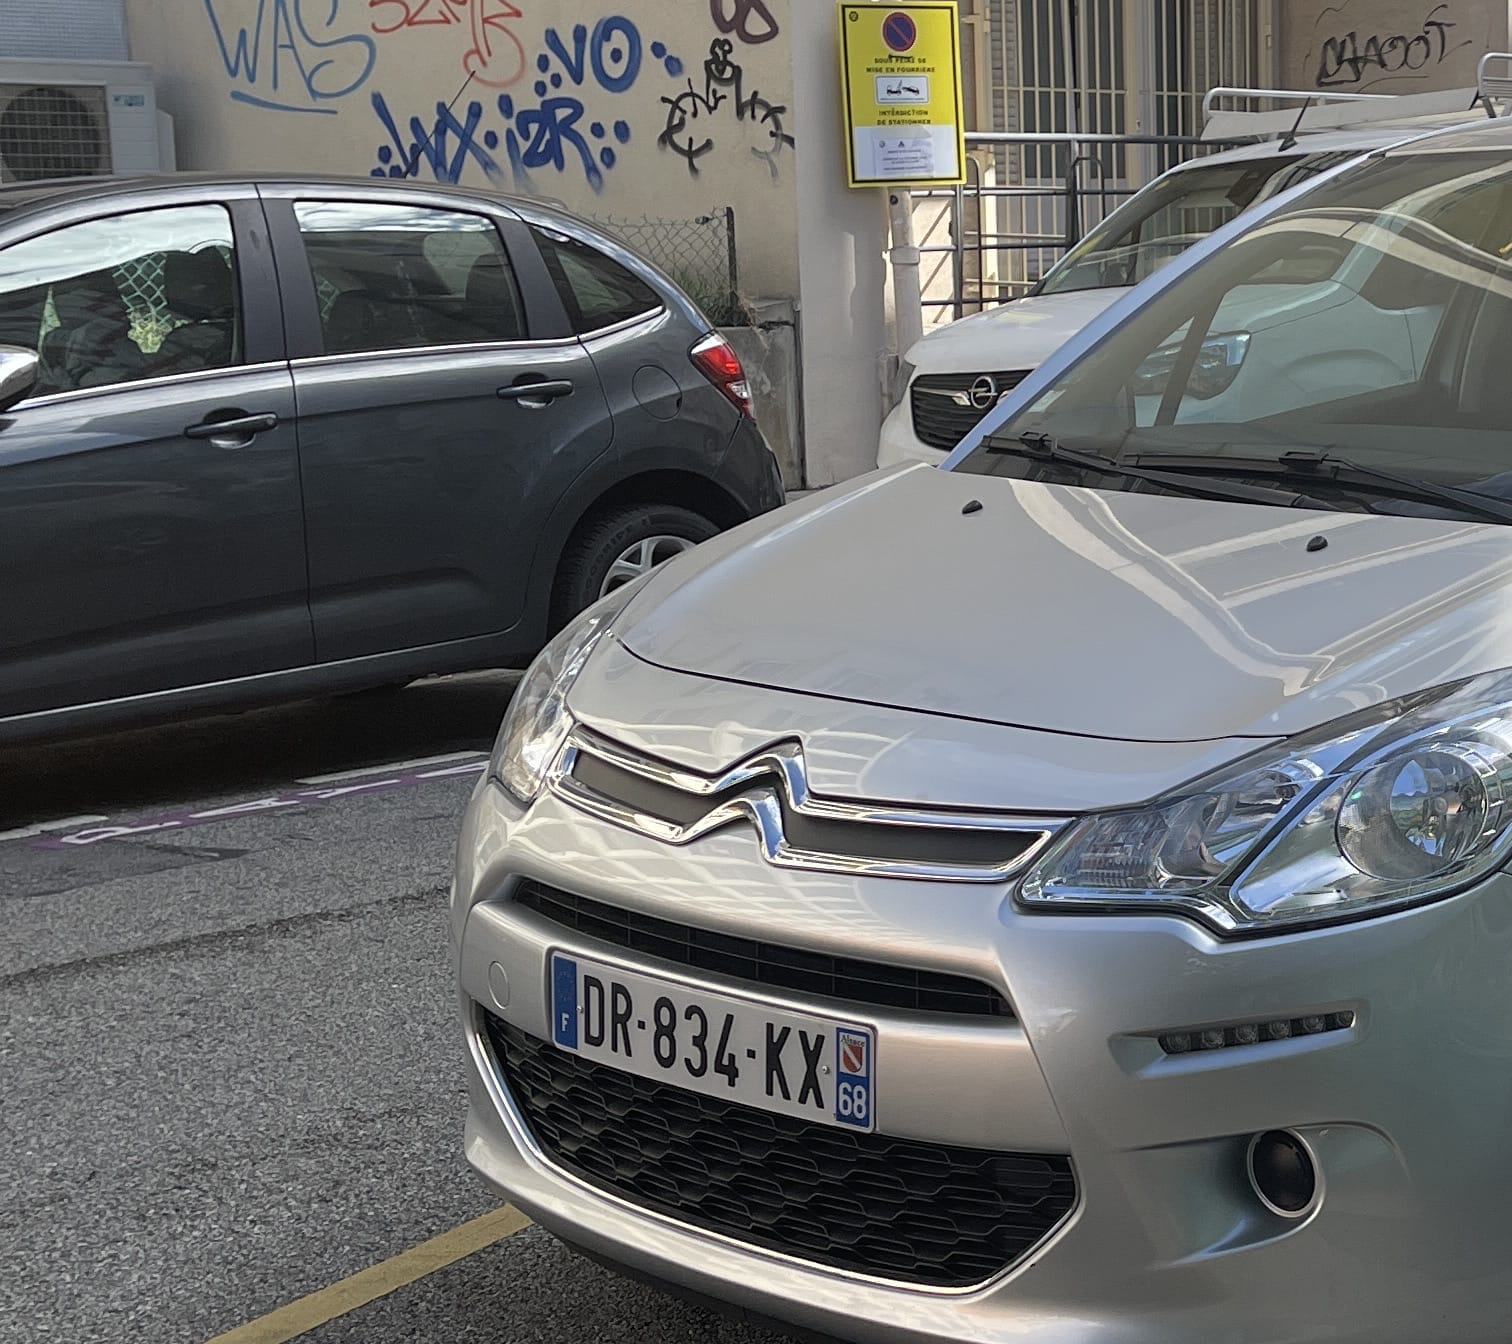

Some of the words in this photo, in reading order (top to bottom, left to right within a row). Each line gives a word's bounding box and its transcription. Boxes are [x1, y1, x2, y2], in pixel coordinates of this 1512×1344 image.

[583, 973, 826, 1110] DR-834-KX
[840, 1034, 866, 1049] Alsace
[838, 1081, 867, 1120] 68
